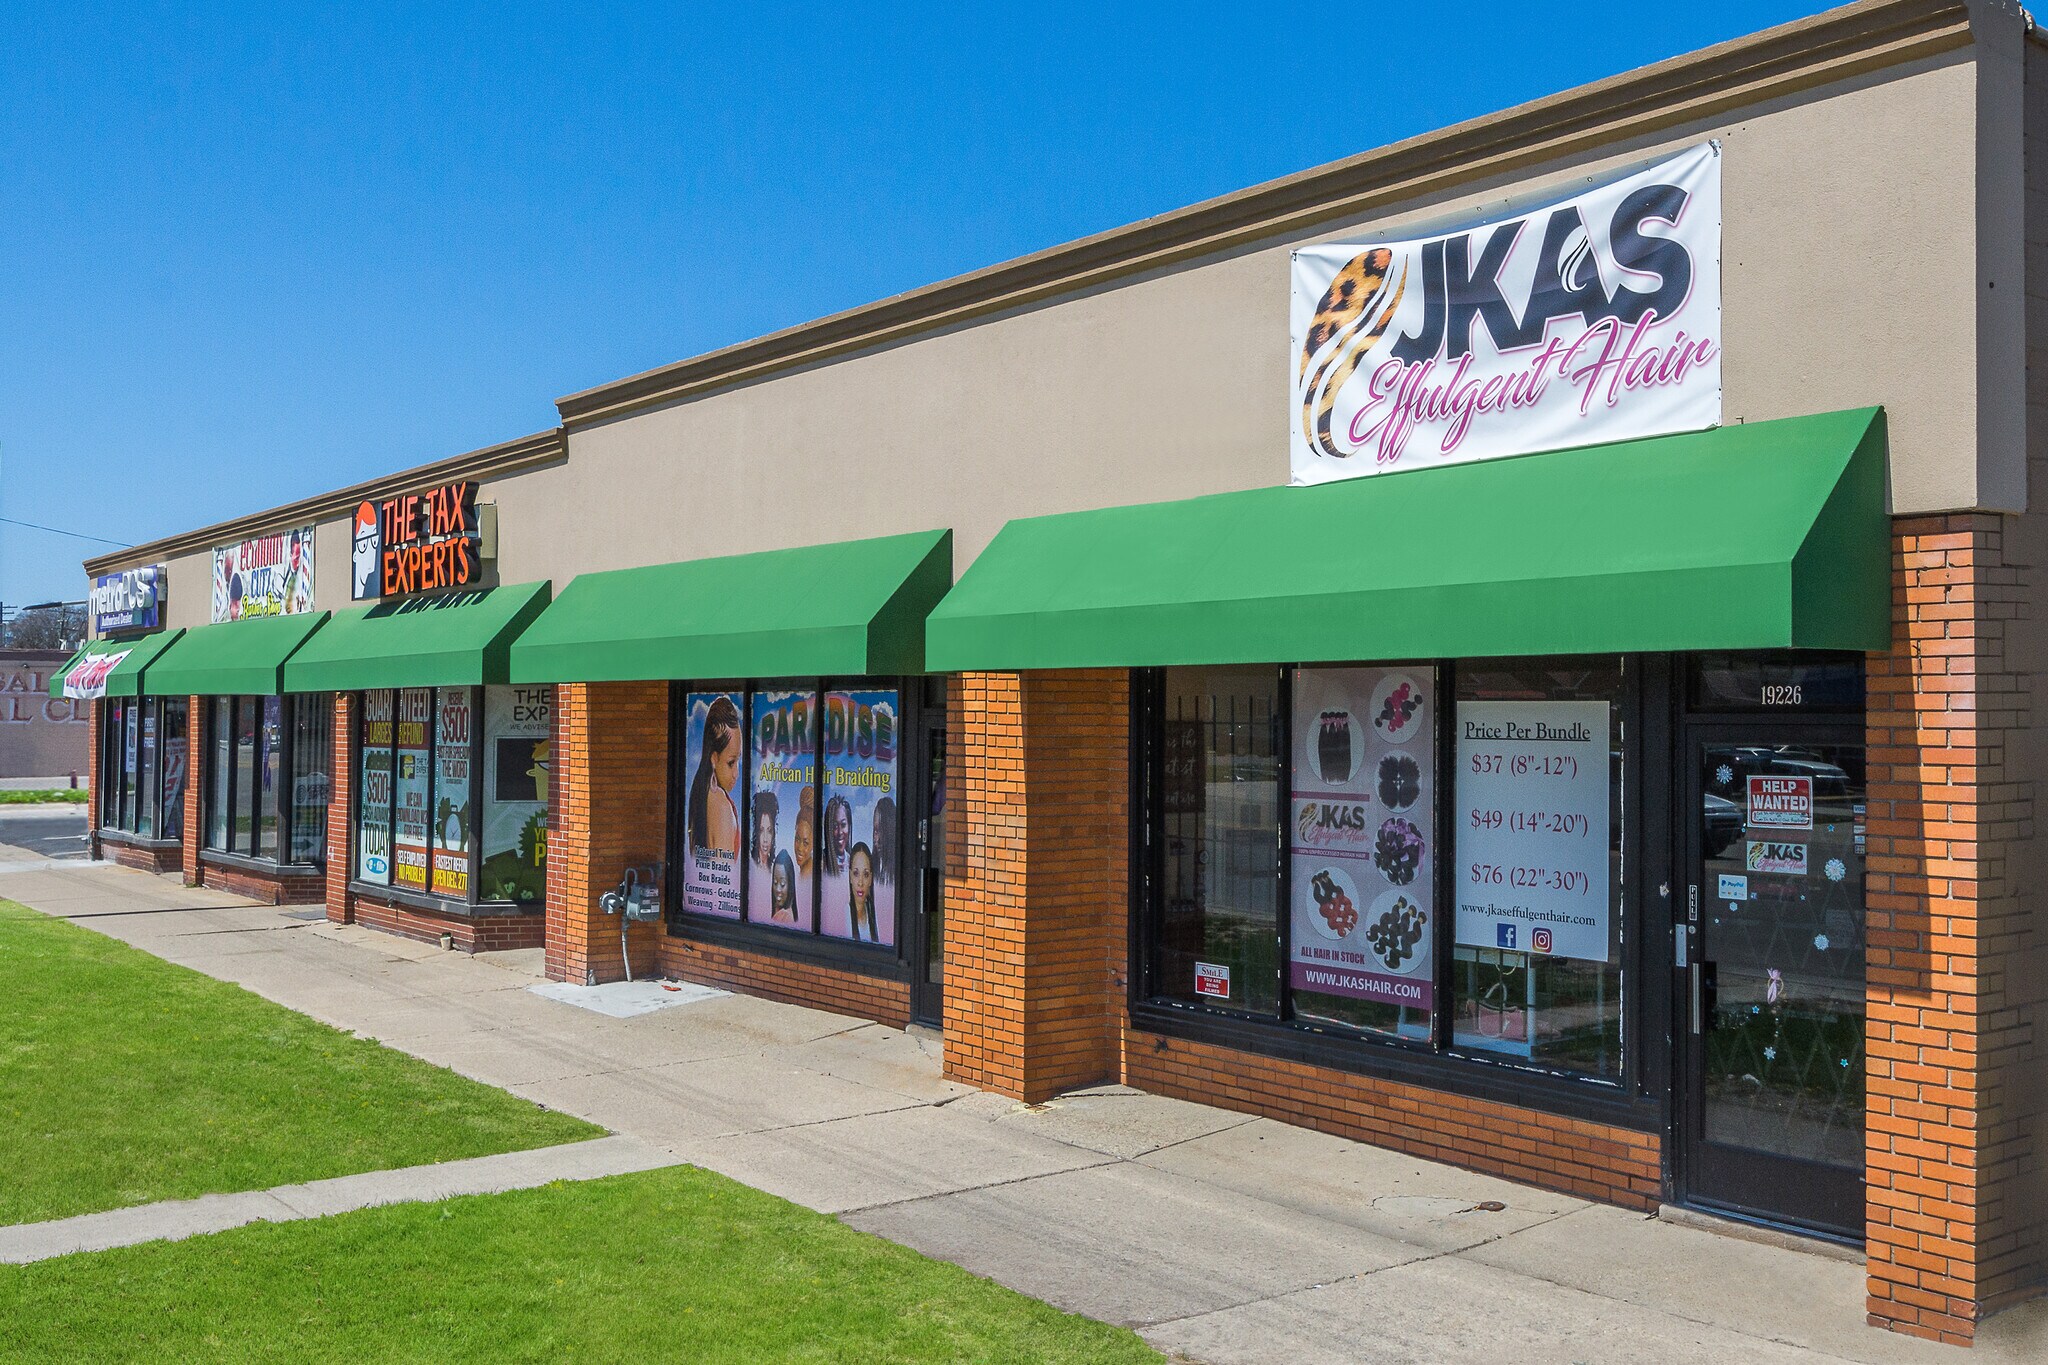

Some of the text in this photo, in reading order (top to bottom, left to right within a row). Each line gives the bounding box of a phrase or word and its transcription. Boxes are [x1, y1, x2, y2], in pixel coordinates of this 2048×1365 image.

[1390, 184, 1695, 368] JKAS
[1349, 309, 1718, 464] Effulgent Hair
[382, 481, 466, 546] THE TAX
[384, 536, 469, 596] EXPERTS
[0, 671, 49, 695] AL
[1760, 685, 1802, 705] 19226
[513, 689, 551, 704] THE
[441, 704, 470, 744] $500
[761, 697, 893, 762] PARDISE
[1464, 721, 1591, 741] Price Per Bundle
[760, 762, 891, 793] African Hir Braiding
[1471, 753, 1578, 780] $37 (8"-12")
[1762, 780, 1797, 794] HELP
[1752, 794, 1809, 811] WANTED
[1316, 804, 1366, 831] JKAS
[1471, 808, 1589, 838] $49 (14"-20")
[1763, 843, 1804, 862] JKAS
[696, 859, 731, 872] Pixie Braids
[685, 882, 713, 896] Cornrows
[698, 871, 731, 885] Box Braids
[1471, 862, 1589, 896] $76 (22"-30")
[687, 895, 713, 911] Weaving
[1461, 903, 1597, 926] www.jkaseffulgenthair.com
[1301, 946, 1366, 965] ALL HAIR IN STOCK
[1305, 969, 1421, 1000] WWW.JKASHAIR.COM
